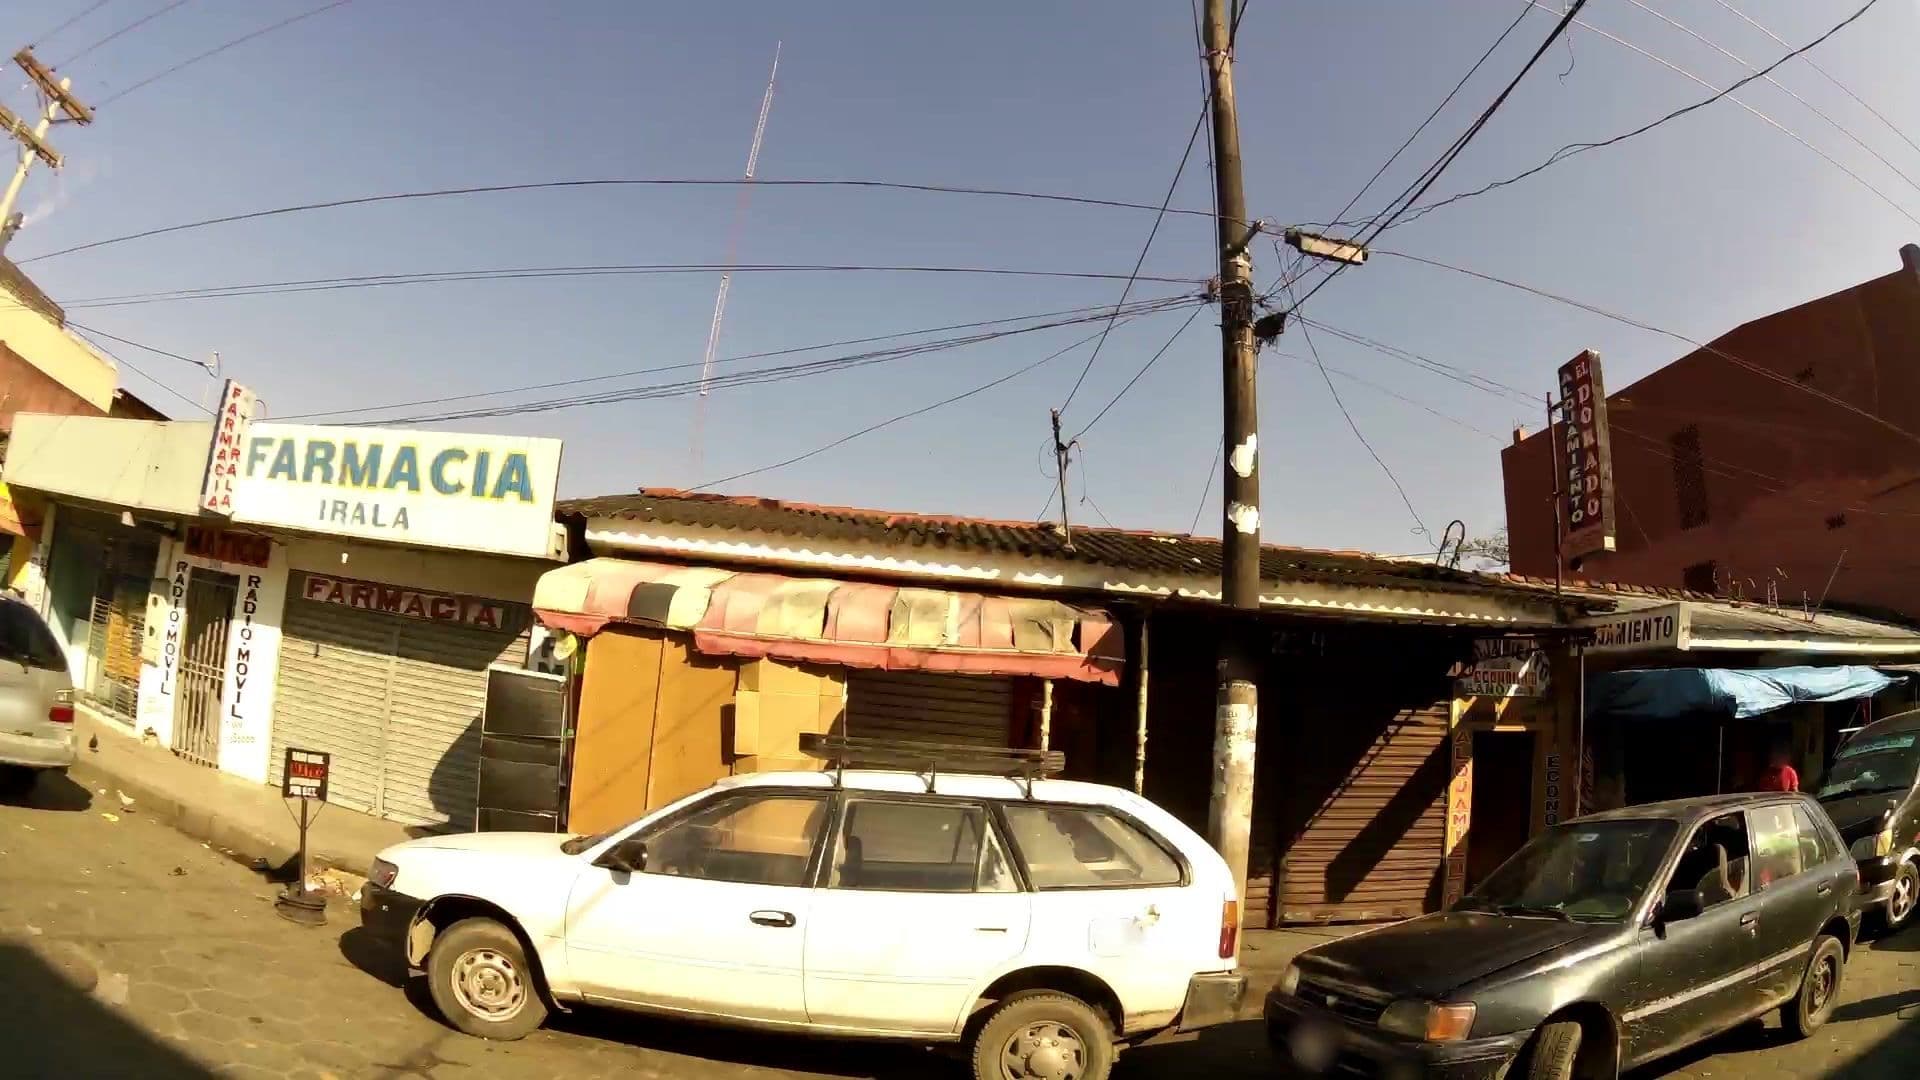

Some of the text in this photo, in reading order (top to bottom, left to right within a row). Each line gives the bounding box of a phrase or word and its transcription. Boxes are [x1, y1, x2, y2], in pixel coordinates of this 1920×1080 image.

[208, 387, 242, 507] FARMACIA
[221, 433, 241, 508] IRALA
[246, 436, 534, 503] FARMACIA
[319, 499, 409, 530] IRALA
[305, 579, 500, 628] FARMACIA
